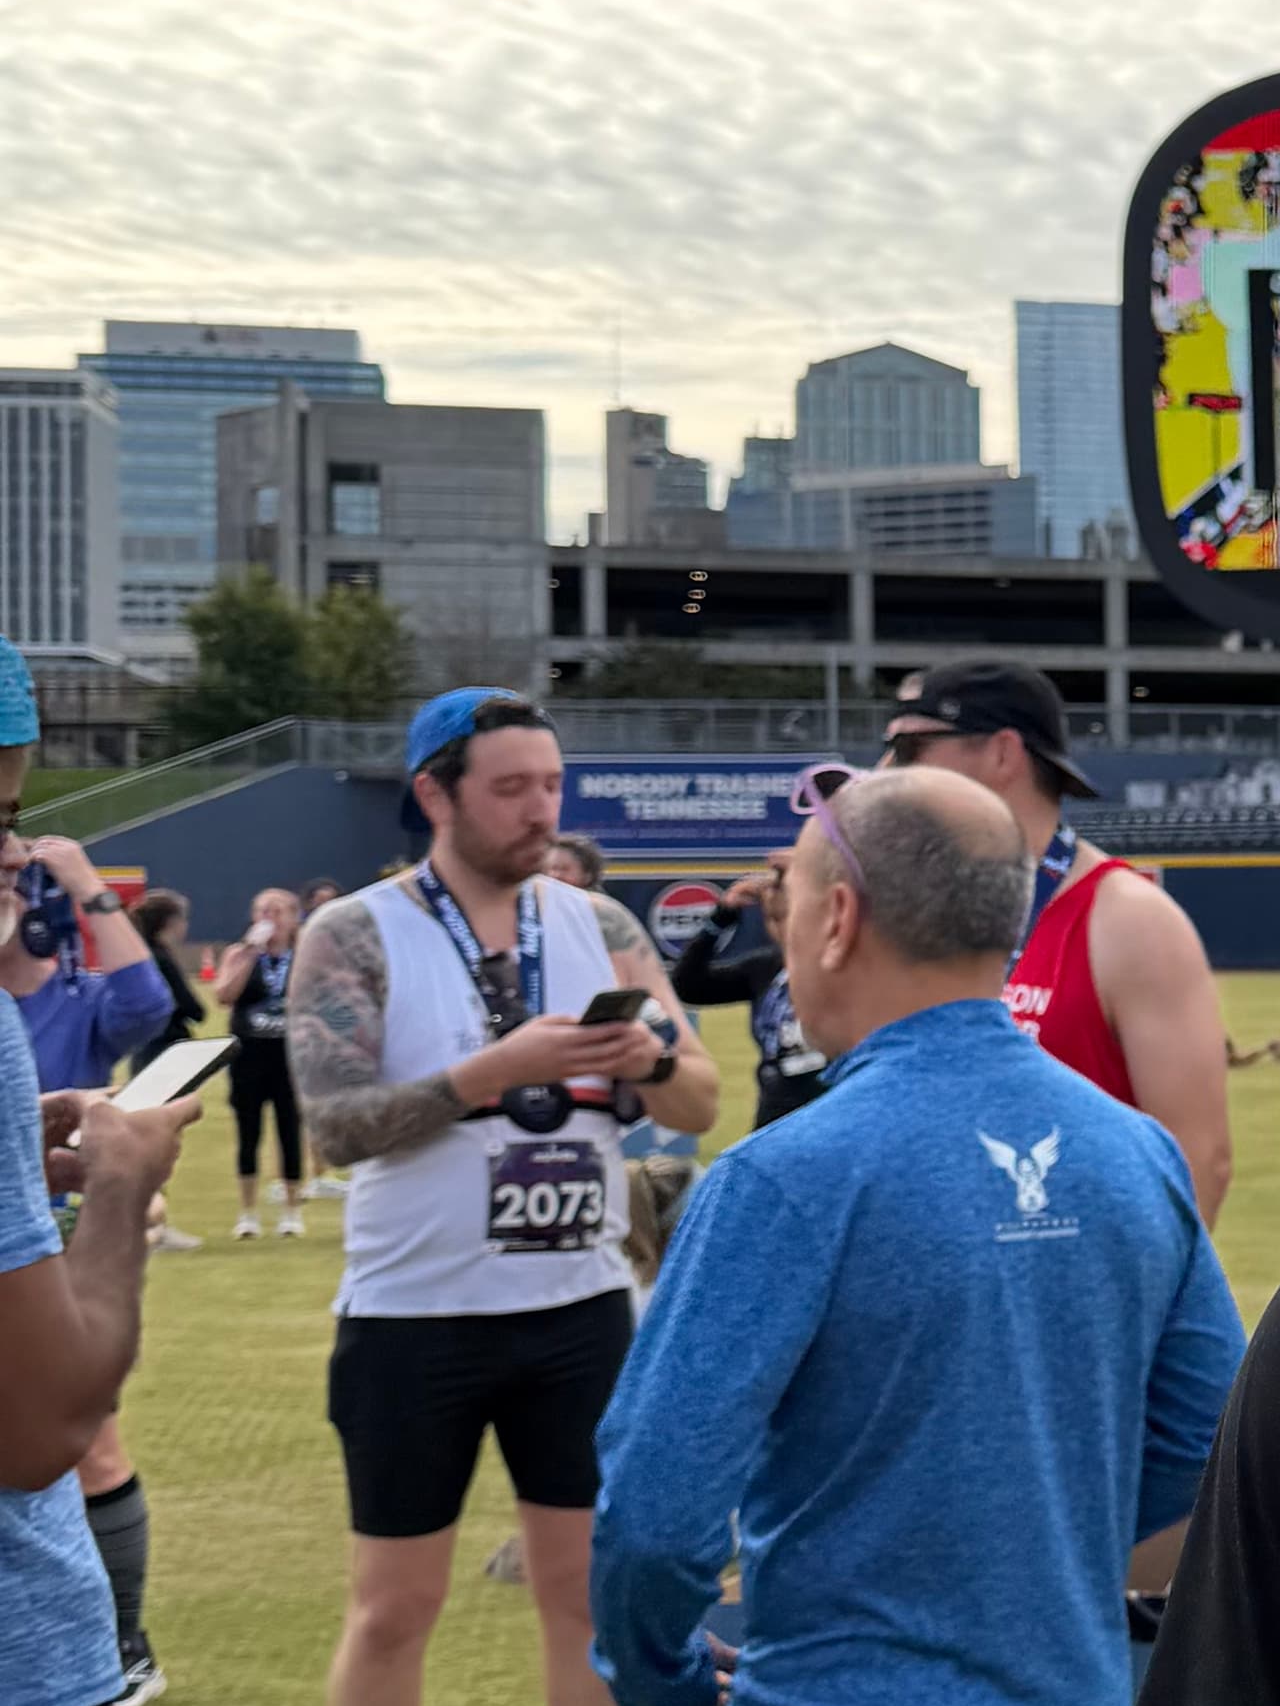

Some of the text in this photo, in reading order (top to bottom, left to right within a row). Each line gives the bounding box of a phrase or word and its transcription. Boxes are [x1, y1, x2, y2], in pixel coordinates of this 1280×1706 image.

[579, 773, 795, 798] NOBODY TRASHE
[624, 797, 768, 821] TENNESSEE
[490, 1180, 604, 1229] 2073
